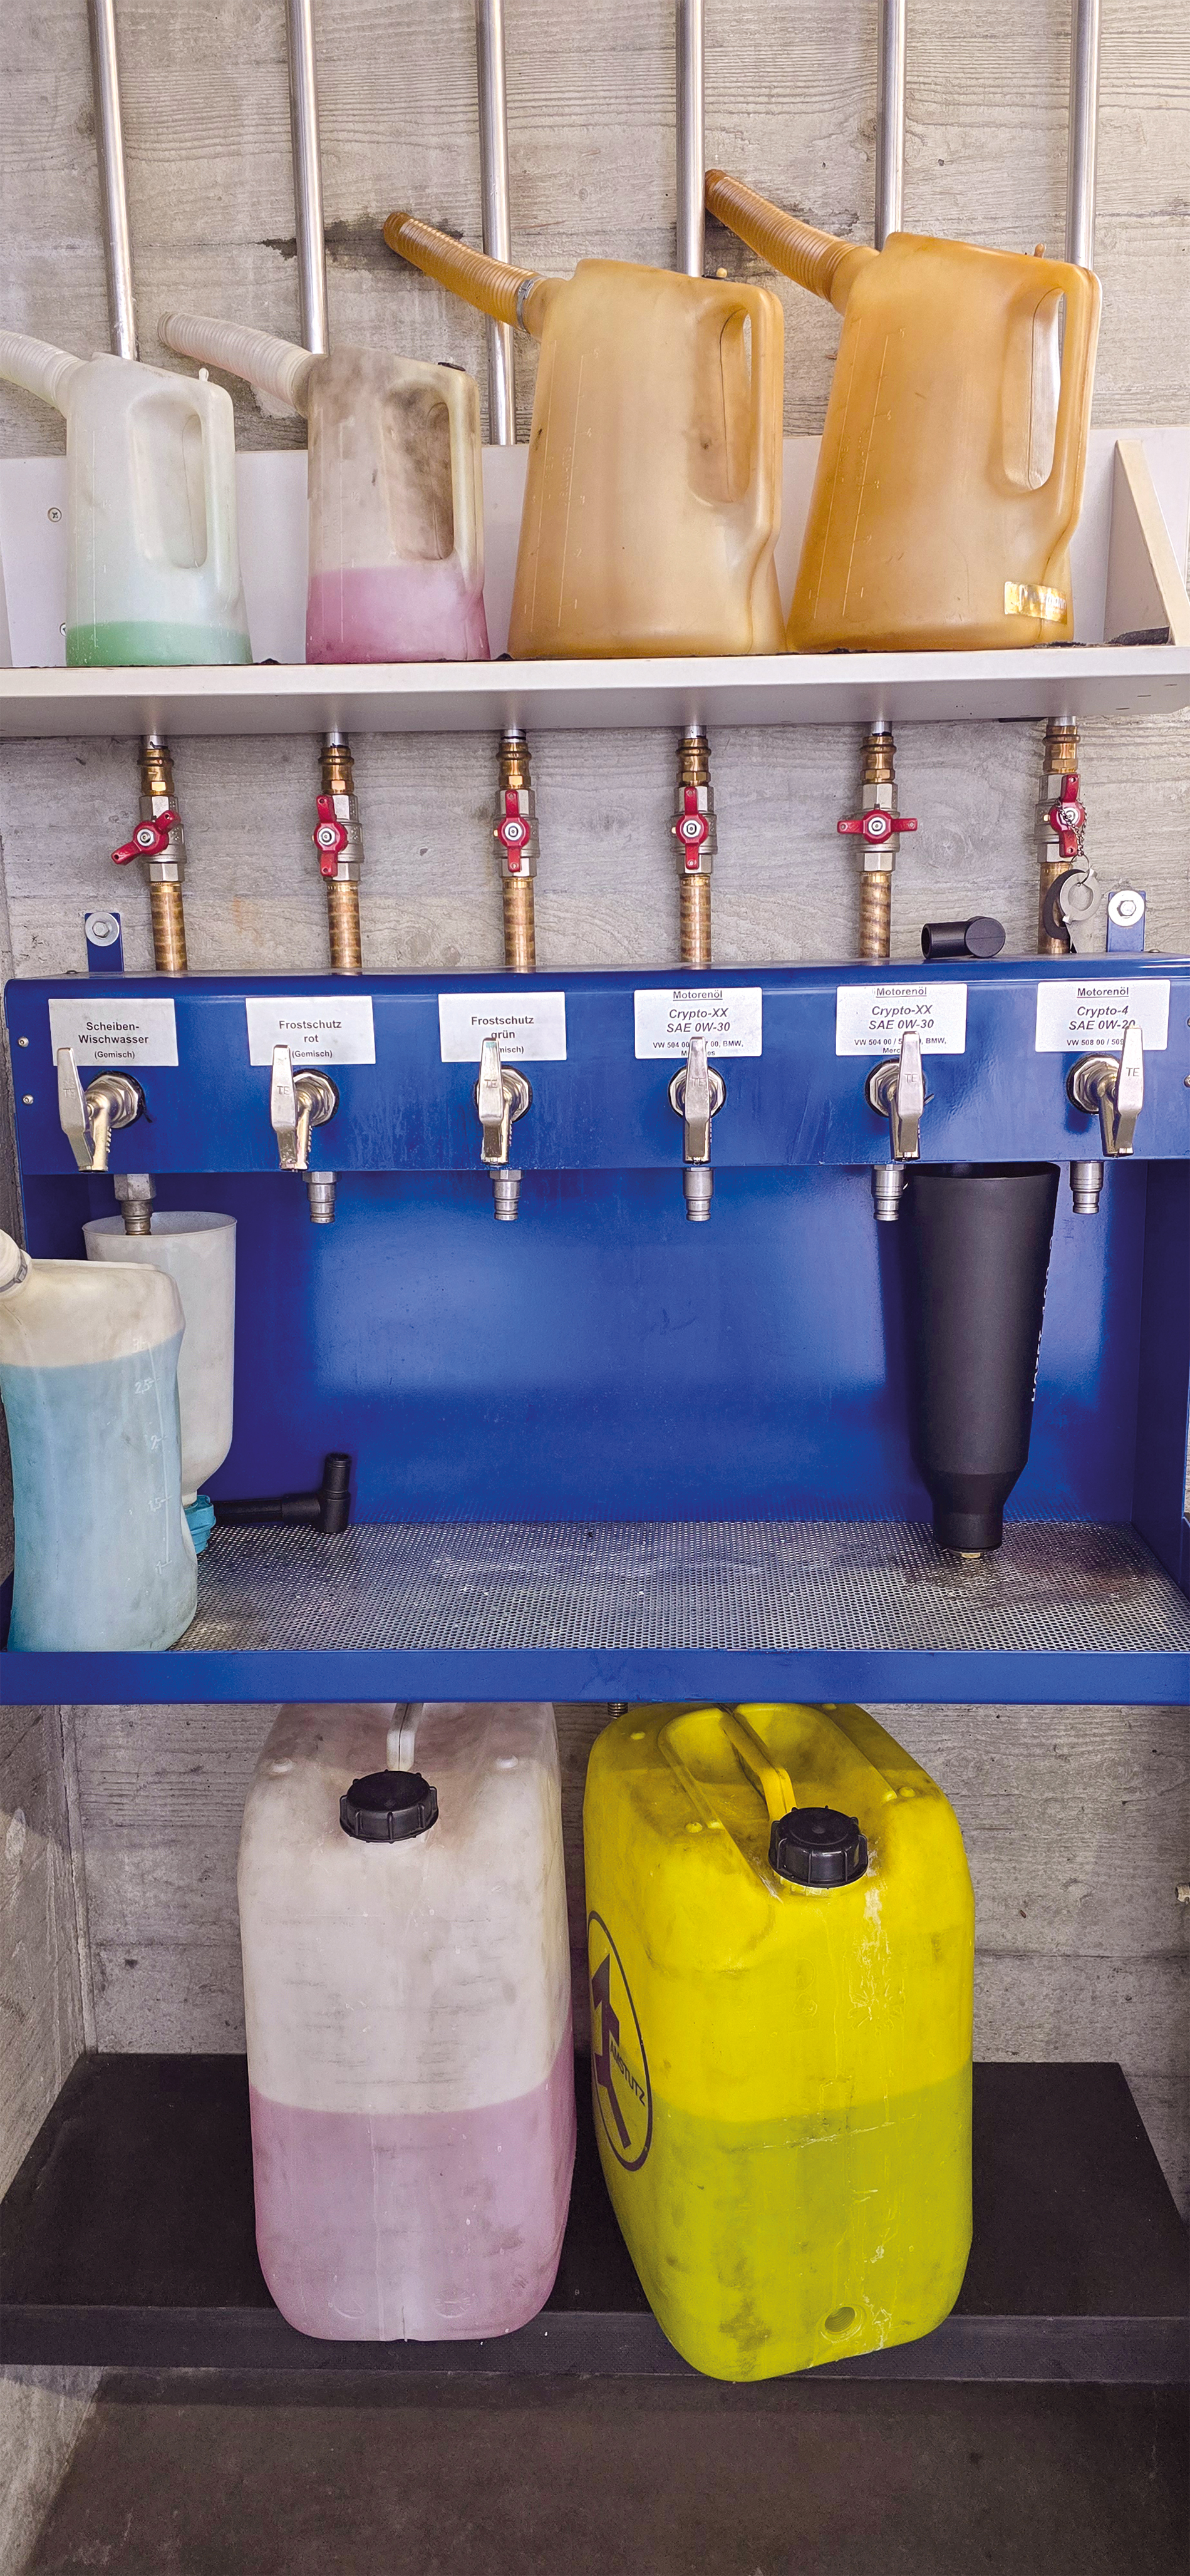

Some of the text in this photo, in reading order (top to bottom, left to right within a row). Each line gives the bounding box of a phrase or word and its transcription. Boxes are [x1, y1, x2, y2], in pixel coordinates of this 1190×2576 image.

[673, 990, 723, 1000] Motorenöl
[876, 986, 927, 997] Motorenöl
[1077, 986, 1129, 997] Motorenöl
[669, 1007, 729, 1021] Crypto-XX
[871, 1005, 933, 1018] Crypto-XX
[1077, 1005, 1129, 1018] Crypto-4
[279, 1020, 342, 1029] Frostschutz
[471, 1015, 534, 1025] Frostschutz
[869, 1019, 934, 1030] SAE 0W-30
[1068, 1020, 1136, 1030] SAE 0W-20
[86, 1022, 140, 1031] Scheiben-
[666, 1022, 730, 1033] SAE 0W-30
[78, 1035, 149, 1043] Wischwasser
[304, 1035, 319, 1043] rot
[723, 1040, 744, 1048] BMW,
[94, 1051, 135, 1060] (Gemisch)
[292, 1050, 333, 1058] (Gemisch)
[499, 1046, 524, 1055] misch)
[1127, 1067, 1140, 1077] TE
[484, 1079, 499, 1089] TE
[277, 1085, 291, 1095] TE
[610, 2040, 646, 2108] AMSTUTZ
